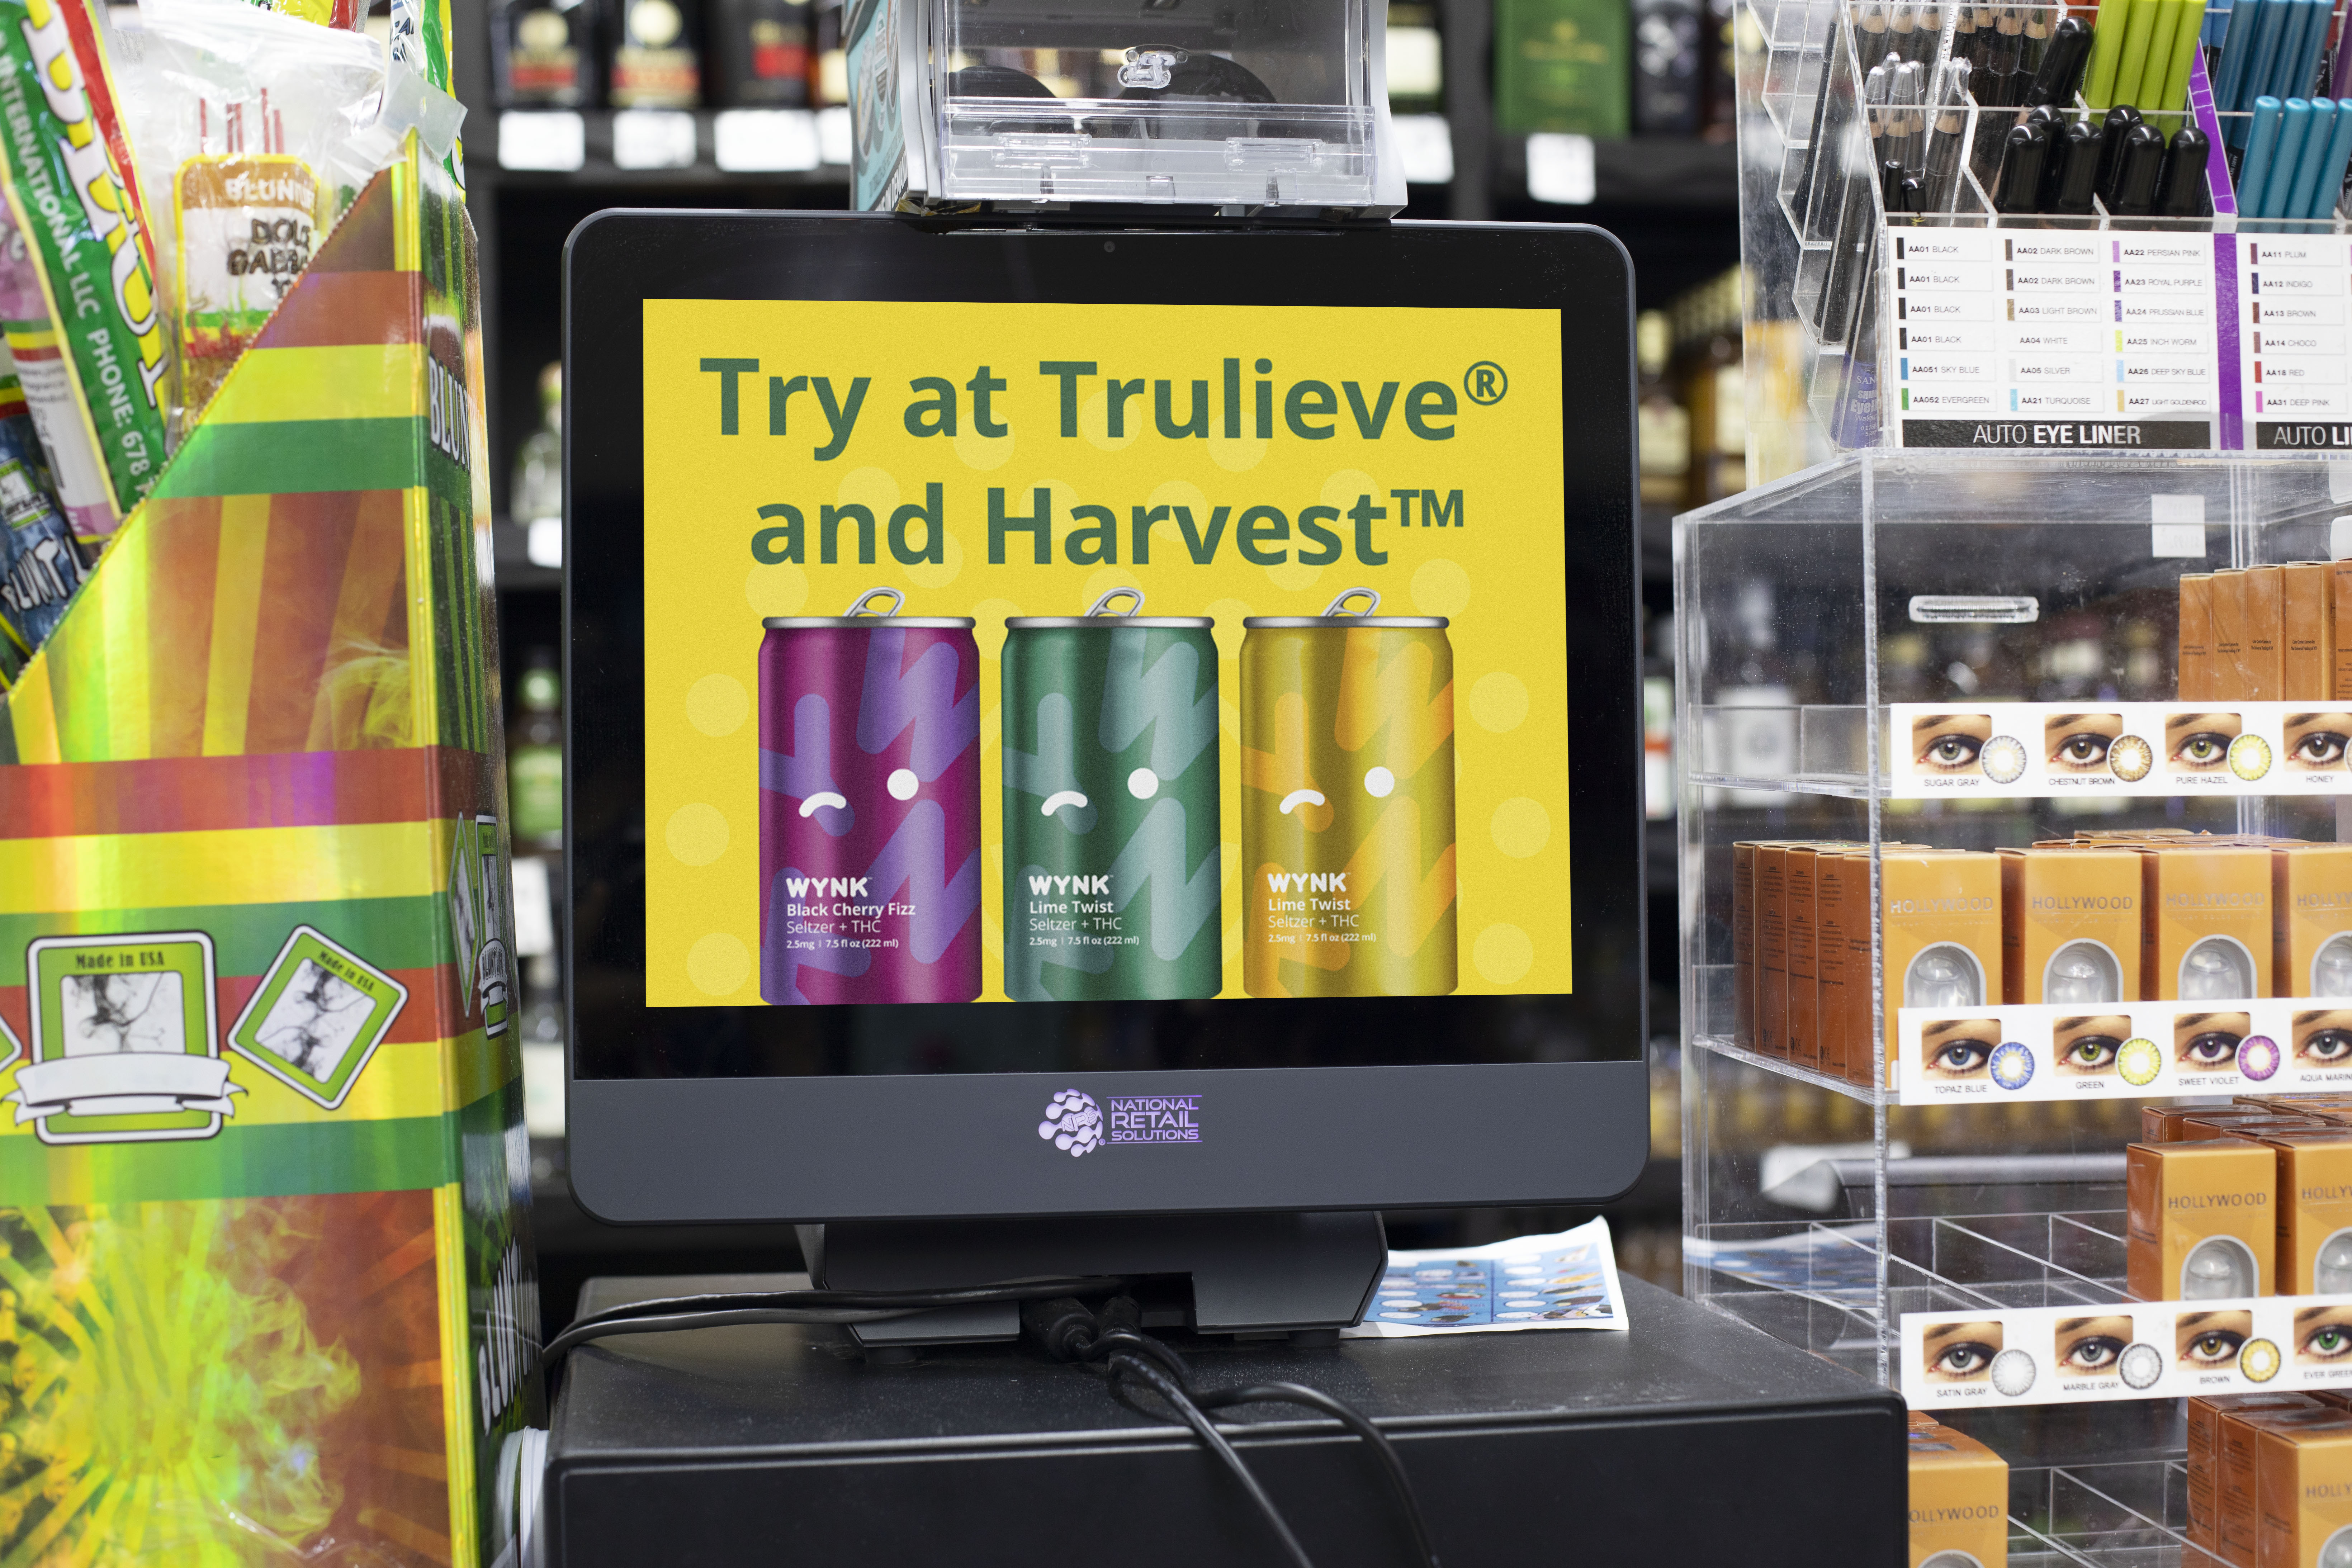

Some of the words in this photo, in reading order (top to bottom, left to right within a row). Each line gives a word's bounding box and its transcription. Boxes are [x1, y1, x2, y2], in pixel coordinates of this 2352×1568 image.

[891, 149, 908, 209] DEMAND
[69, 271, 100, 319] LLC
[87, 327, 134, 429] PHONE:
[120, 430, 151, 477] 678
[700, 358, 872, 461] Try
[904, 366, 1008, 438] at
[1973, 425, 2027, 444] AUTO
[2033, 425, 2073, 444] EYE
[2079, 425, 2142, 445] LINER
[2273, 426, 2326, 445] AUTO
[2332, 426, 2352, 445] LI
[751, 482, 944, 565] and
[1924, 778, 1954, 787] SUGAR
[1957, 778, 1979, 787] GRAY
[2048, 777, 2086, 786] CHESTNUT
[2089, 777, 2116, 785] BROWN
[2176, 776, 2197, 785] PURE
[2200, 776, 2228, 785] HAZEL
[1268, 897, 1306, 911] Lime
[1310, 897, 1351, 911] Twist
[1890, 897, 1993, 913] HOLLYWOOD
[2032, 896, 2133, 910] HOLLYWOOD
[2166, 892, 2265, 907] HOLLYWOOD
[787, 903, 828, 917] Black
[833, 903, 884, 919] Cherry
[888, 902, 916, 916] Fizz
[1030, 900, 1068, 914] Lime
[1072, 900, 1114, 914] Twist
[787, 920, 835, 934] Seltzer
[851, 920, 881, 933] THC
[1029, 917, 1077, 931] Seltzer
[1093, 917, 1123, 930] THC
[1268, 914, 1316, 928] Seltzer
[1330, 914, 1359, 927] THC
[786, 940, 815, 951] 2.5mg
[825, 939, 839, 948] 7.5
[862, 939, 881, 949] (222
[883, 938, 899, 949] ml)
[1029, 937, 1057, 947] 2.5mg
[1068, 937, 1082, 945] 7.5
[1103, 936, 1123, 946] (222
[1124, 936, 1140, 946] ml)
[1268, 934, 1296, 944] 2.5mg
[1306, 934, 1319, 942] 7.5
[1340, 933, 1360, 943] (222
[1362, 933, 1377, 943] ml)
[76, 953, 113, 969] Made
[120, 952, 134, 968] in
[141, 951, 164, 966] USA
[2076, 1081, 2105, 1090] GREEN
[2178, 1077, 2206, 1086] SWEET
[2210, 1076, 2239, 1085] VIOLET
[1934, 1085, 1963, 1094] TOPAZ
[1965, 1084, 1988, 1093] BLUE
[1111, 1098, 1199, 1111] NATIONAL
[1111, 1110, 1199, 1129] RETAIL
[1111, 1128, 1199, 1141] SOLUTIONS
[2168, 1192, 2267, 1209] HOLLYWOOD
[2200, 1376, 2231, 1384] BROWN
[2304, 1371, 2325, 1379] EVER
[1936, 1389, 1961, 1398] SATIN
[1964, 1388, 1988, 1397] GRAY
[2063, 1382, 2096, 1391] MARBLE
[2098, 1381, 2120, 1390] GRAY
[1908, 1505, 1999, 1523] OLLYWOOD
